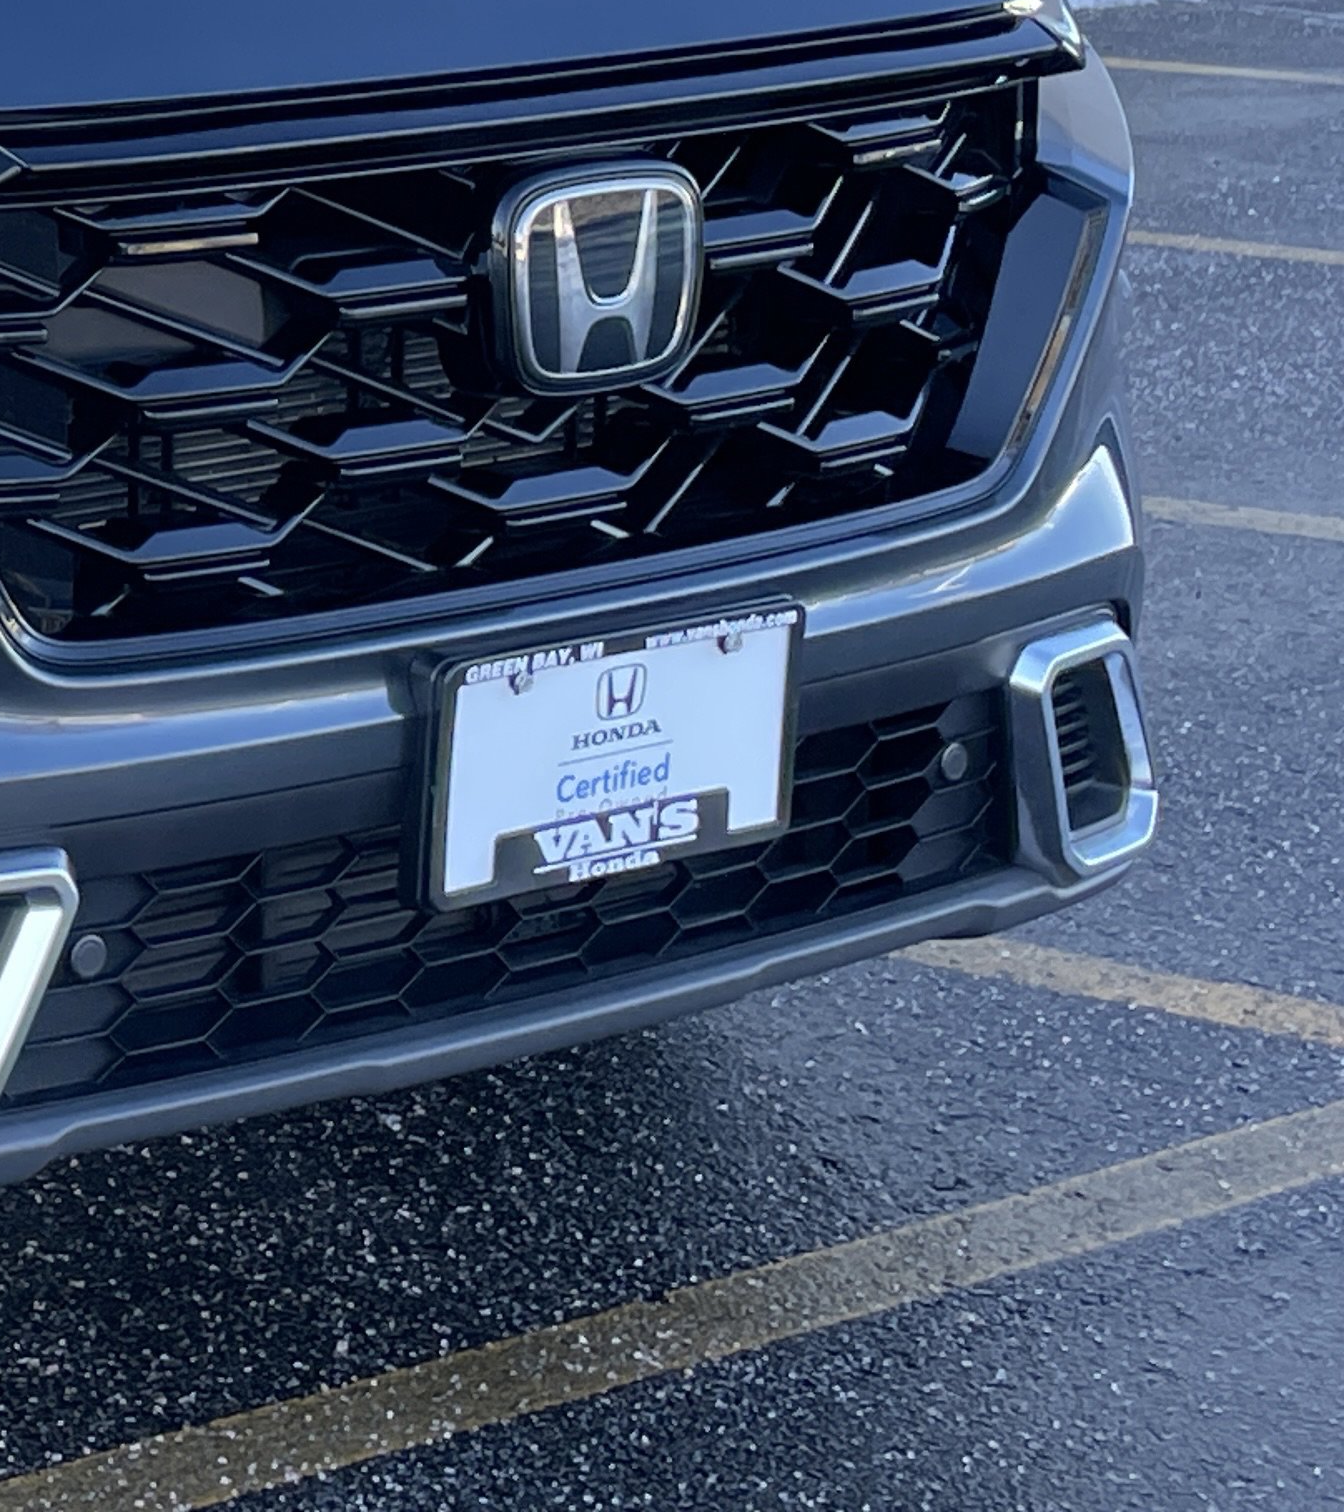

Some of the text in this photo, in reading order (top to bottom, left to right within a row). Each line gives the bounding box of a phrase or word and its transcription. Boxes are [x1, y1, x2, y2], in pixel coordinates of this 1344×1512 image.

[465, 655, 530, 684] GREEN
[579, 641, 605, 662] WI
[570, 718, 662, 751] HONDA
[556, 751, 672, 803] Certified
[568, 849, 661, 883] Honda
